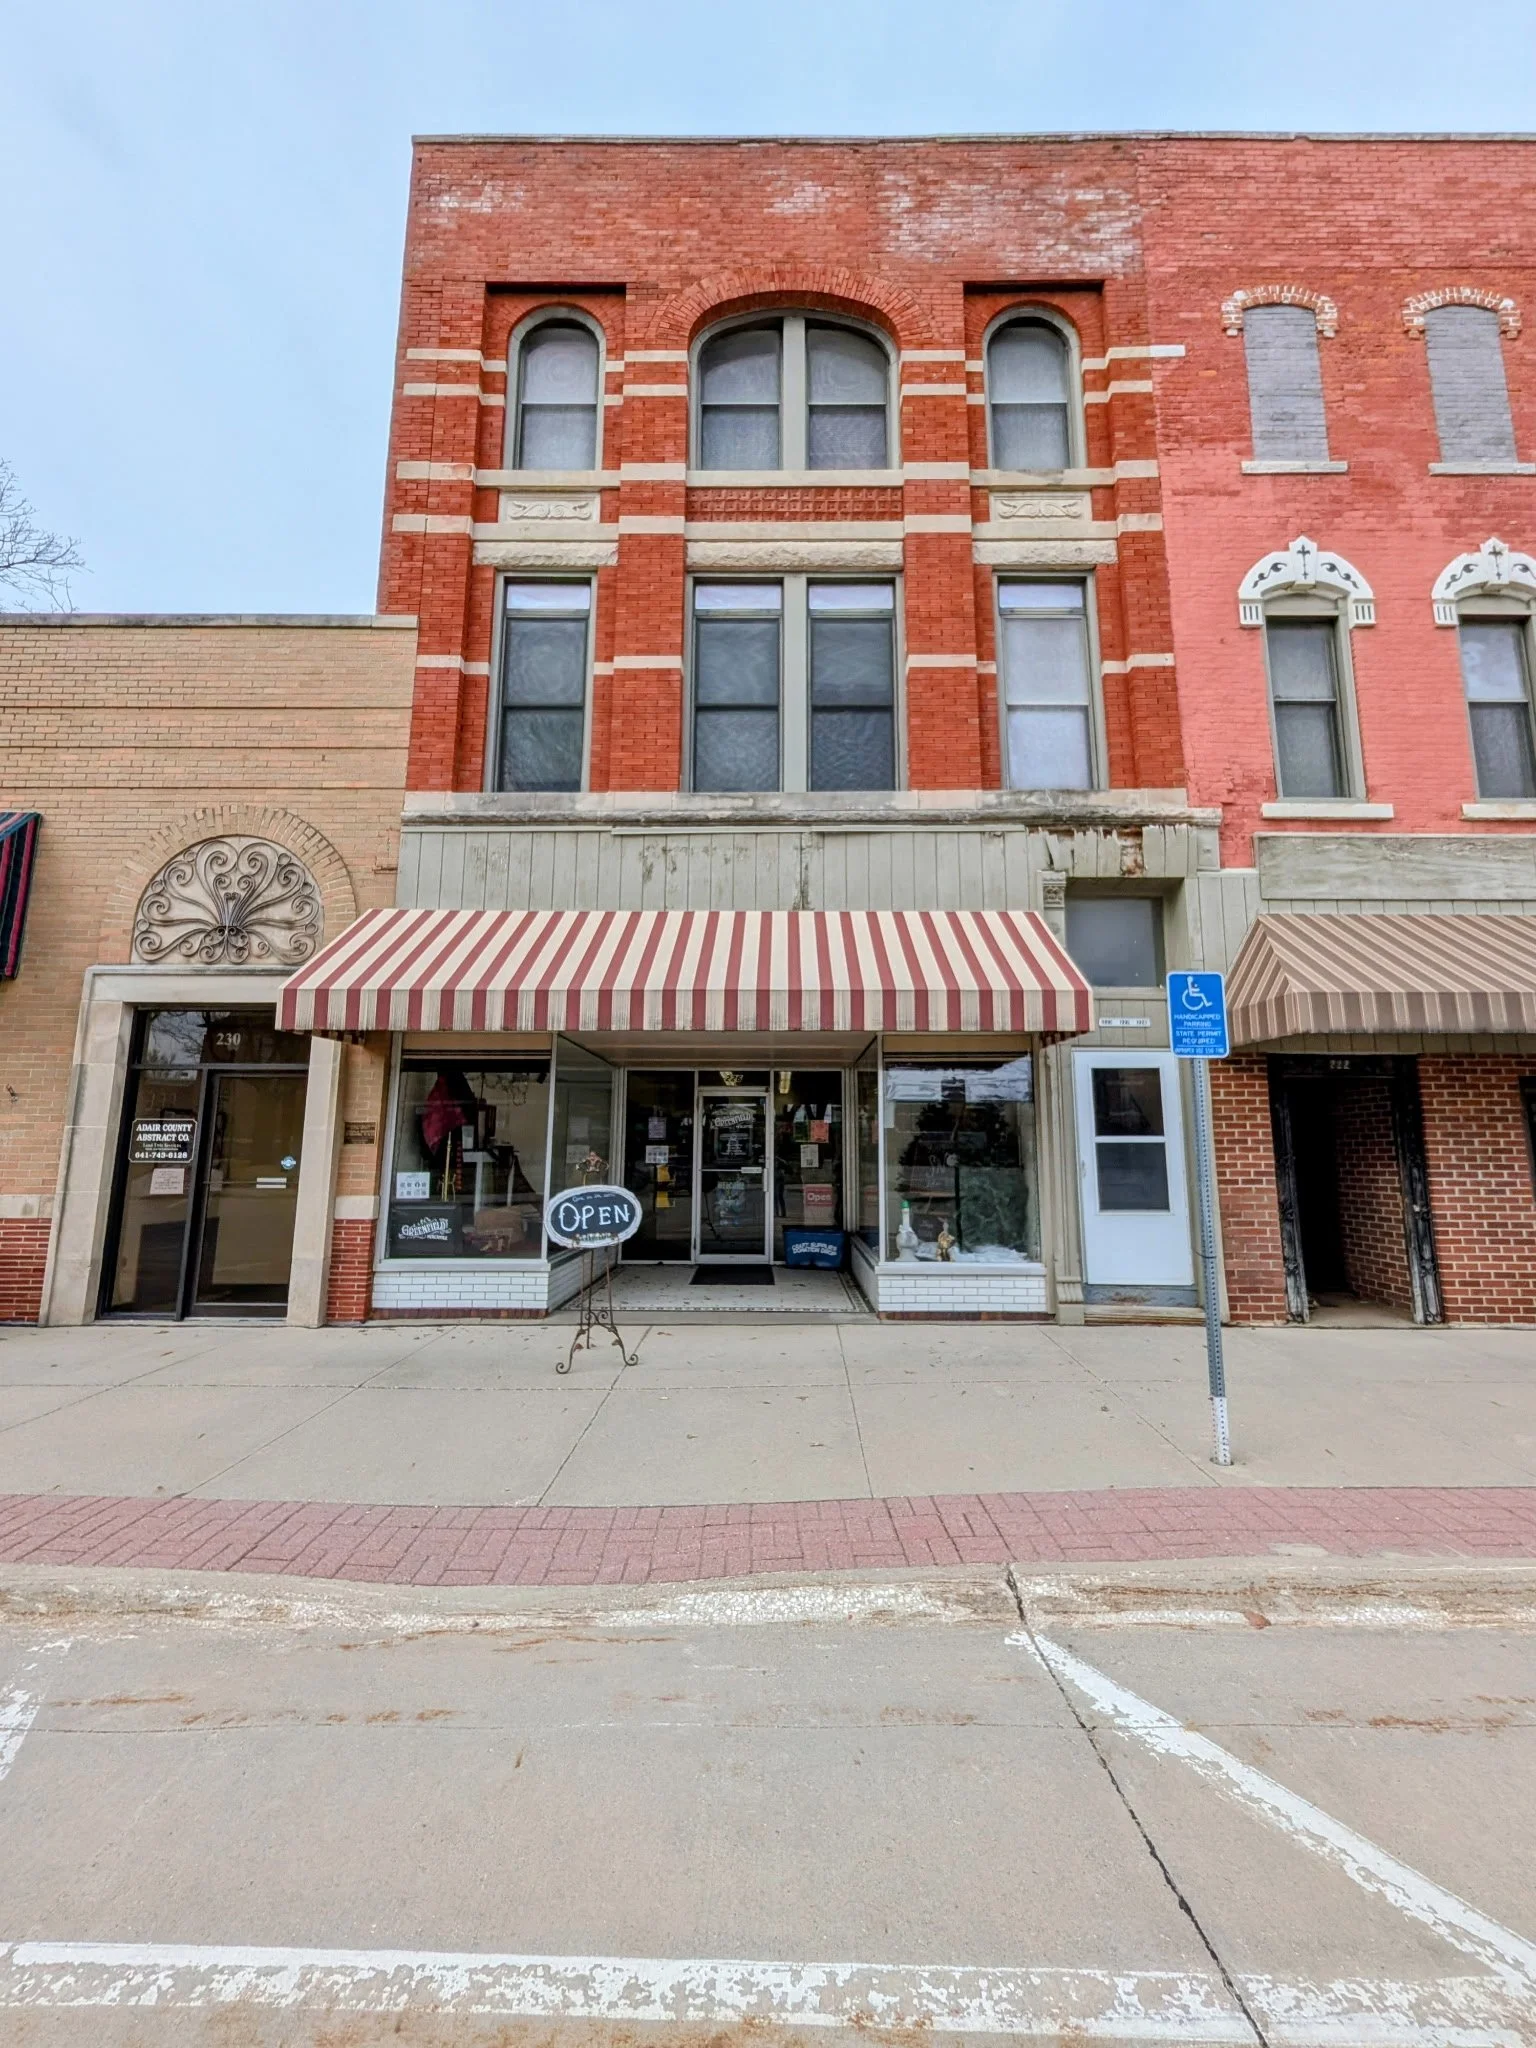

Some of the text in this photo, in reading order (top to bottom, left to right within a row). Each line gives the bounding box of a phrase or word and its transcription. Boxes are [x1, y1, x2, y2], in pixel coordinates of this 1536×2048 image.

[216, 1032, 241, 1045] 230
[136, 1123, 193, 1132] ADAIR COUNTY
[136, 1133, 177, 1142] ABSTRACT
[807, 1192, 832, 1203] Open
[558, 1202, 631, 1232] OPEN
